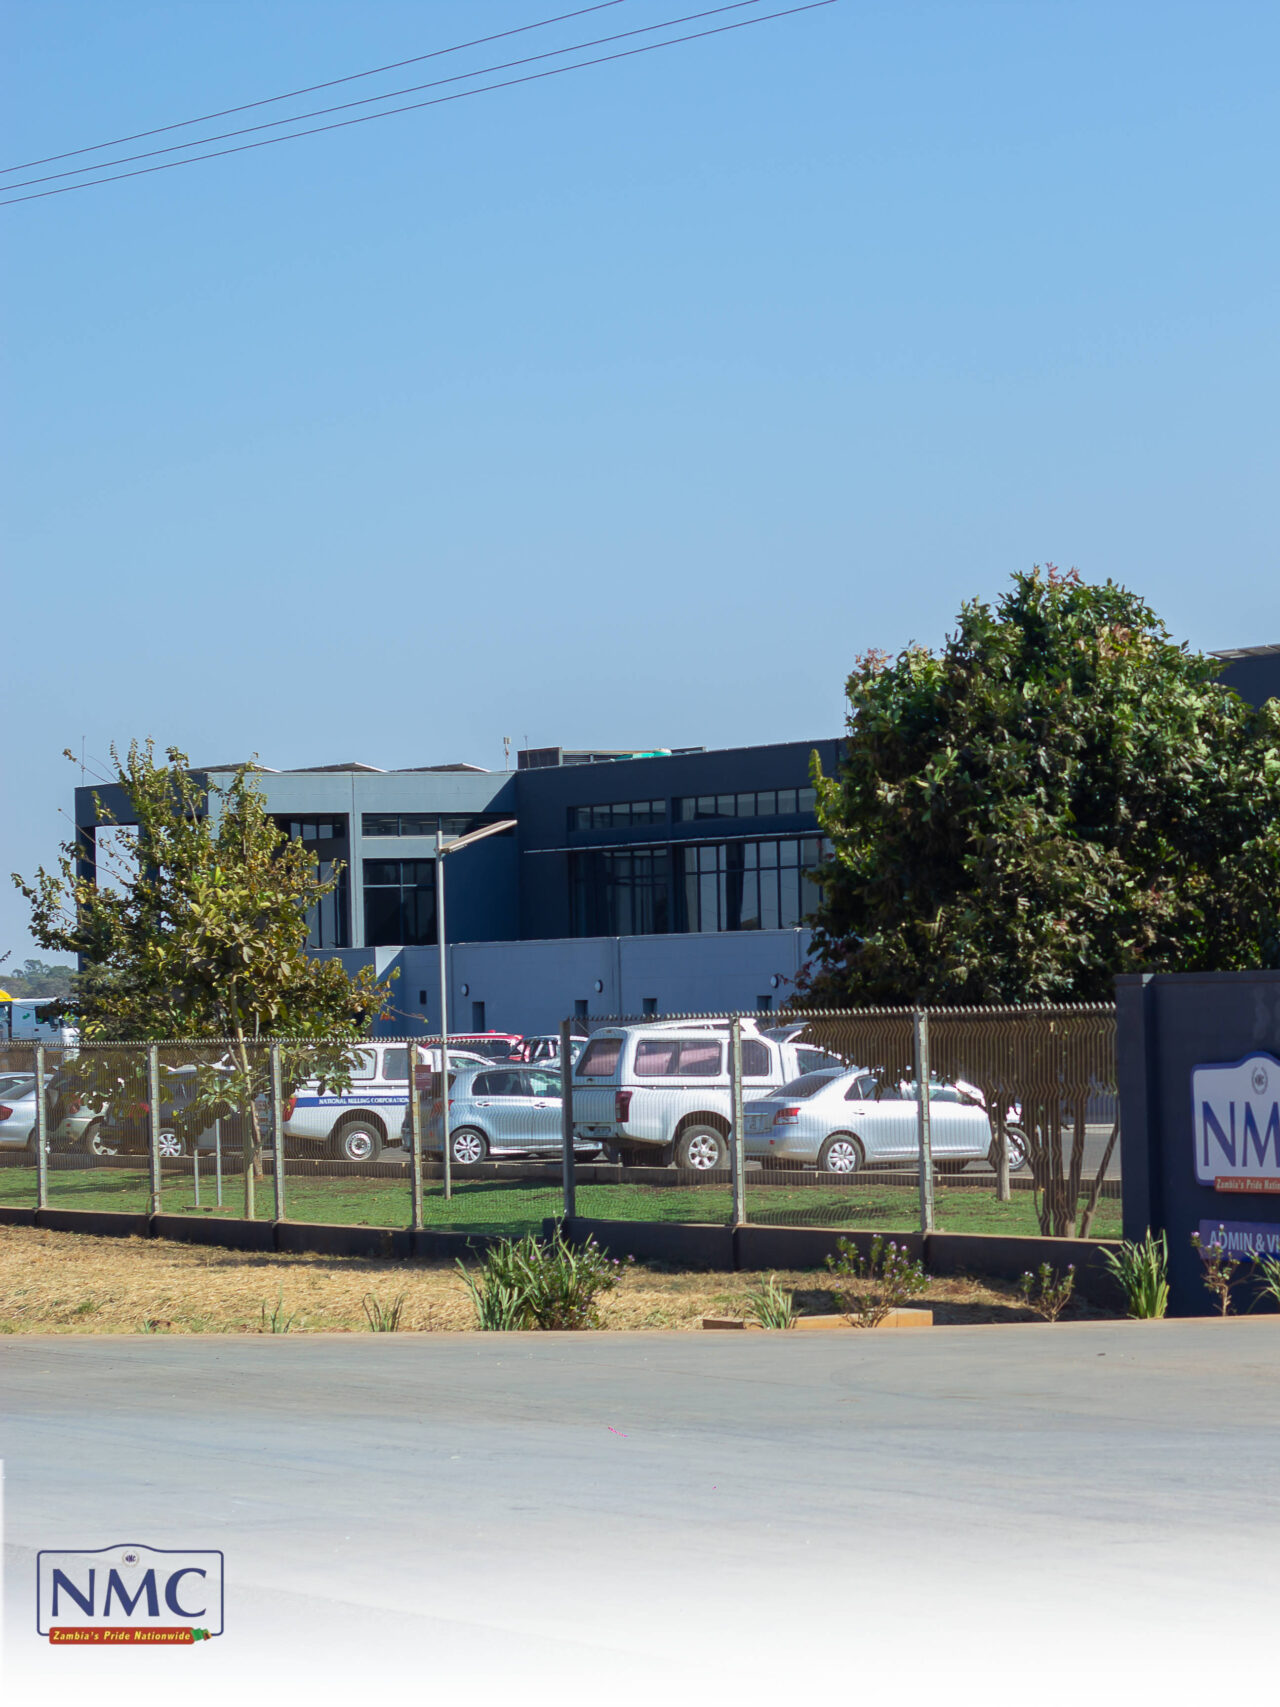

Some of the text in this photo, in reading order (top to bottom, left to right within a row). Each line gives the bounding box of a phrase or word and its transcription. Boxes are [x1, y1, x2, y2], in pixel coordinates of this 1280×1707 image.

[1216, 1178, 1244, 1190] Zambia's
[1246, 1179, 1262, 1190] Pride
[1210, 1231, 1252, 1250] ADMIN
[1256, 1234, 1265, 1252] &
